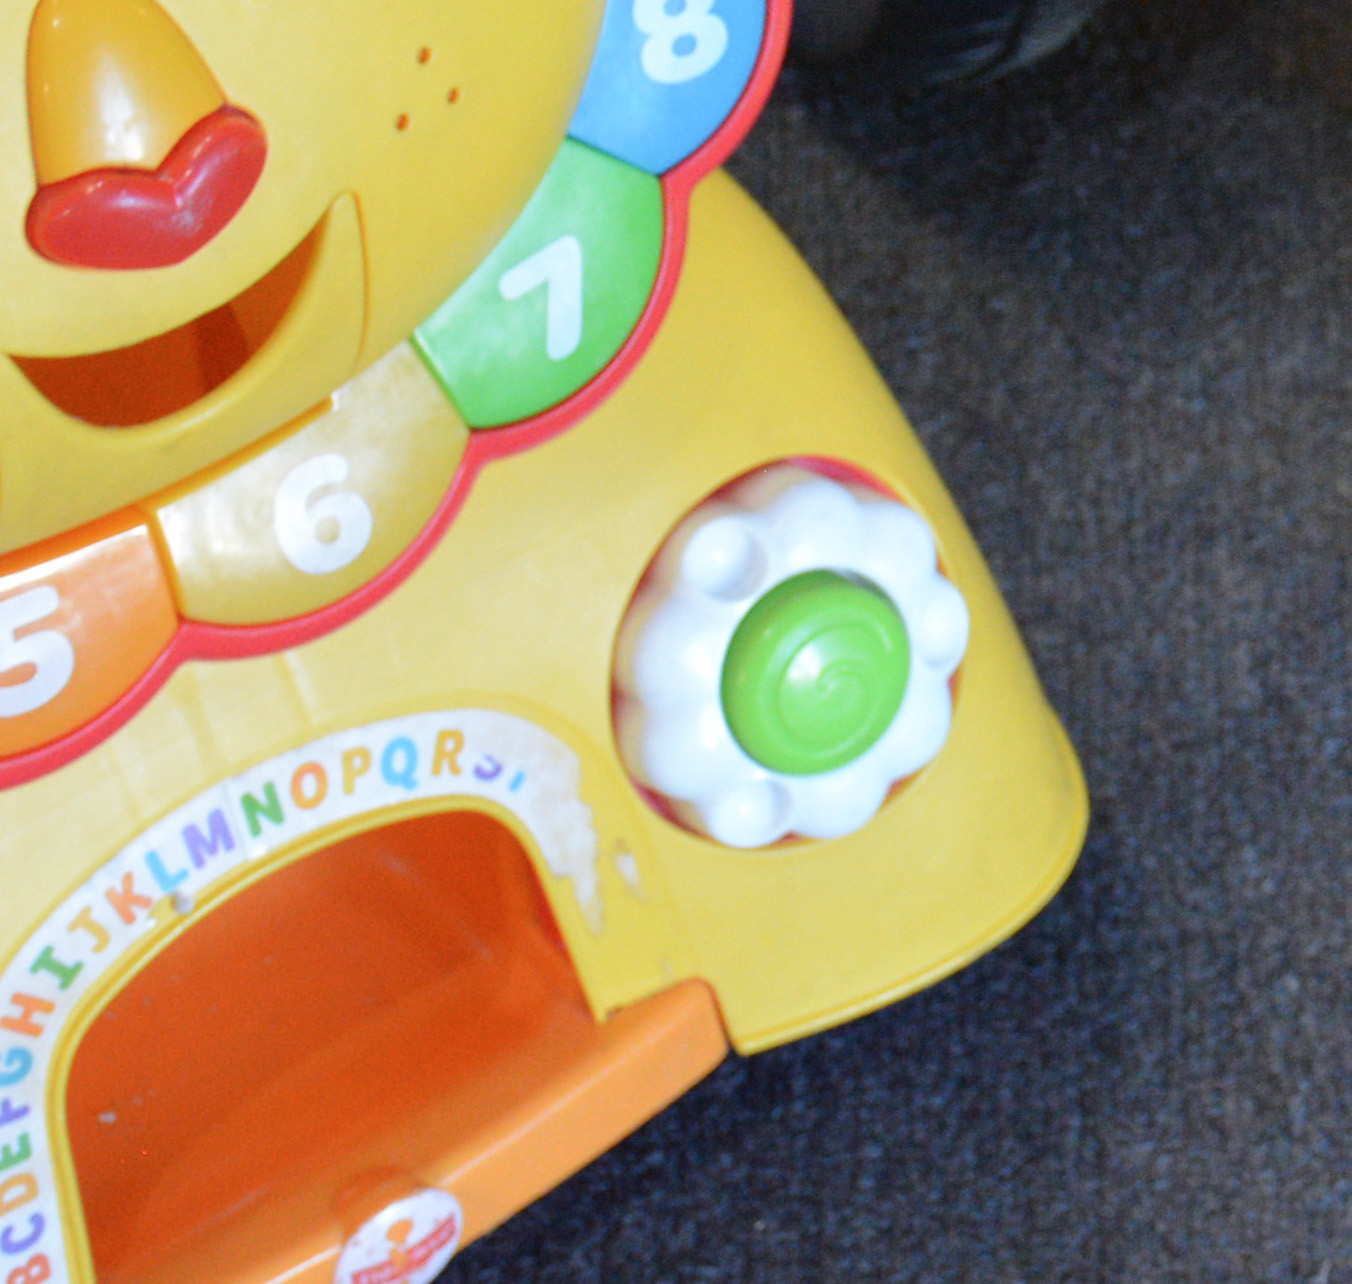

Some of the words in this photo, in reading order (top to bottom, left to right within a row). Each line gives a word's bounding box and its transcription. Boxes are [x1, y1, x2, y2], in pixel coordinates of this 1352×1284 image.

[498, 236, 583, 360] 7
[274, 452, 373, 575] 6
[0, 584, 76, 718] 5
